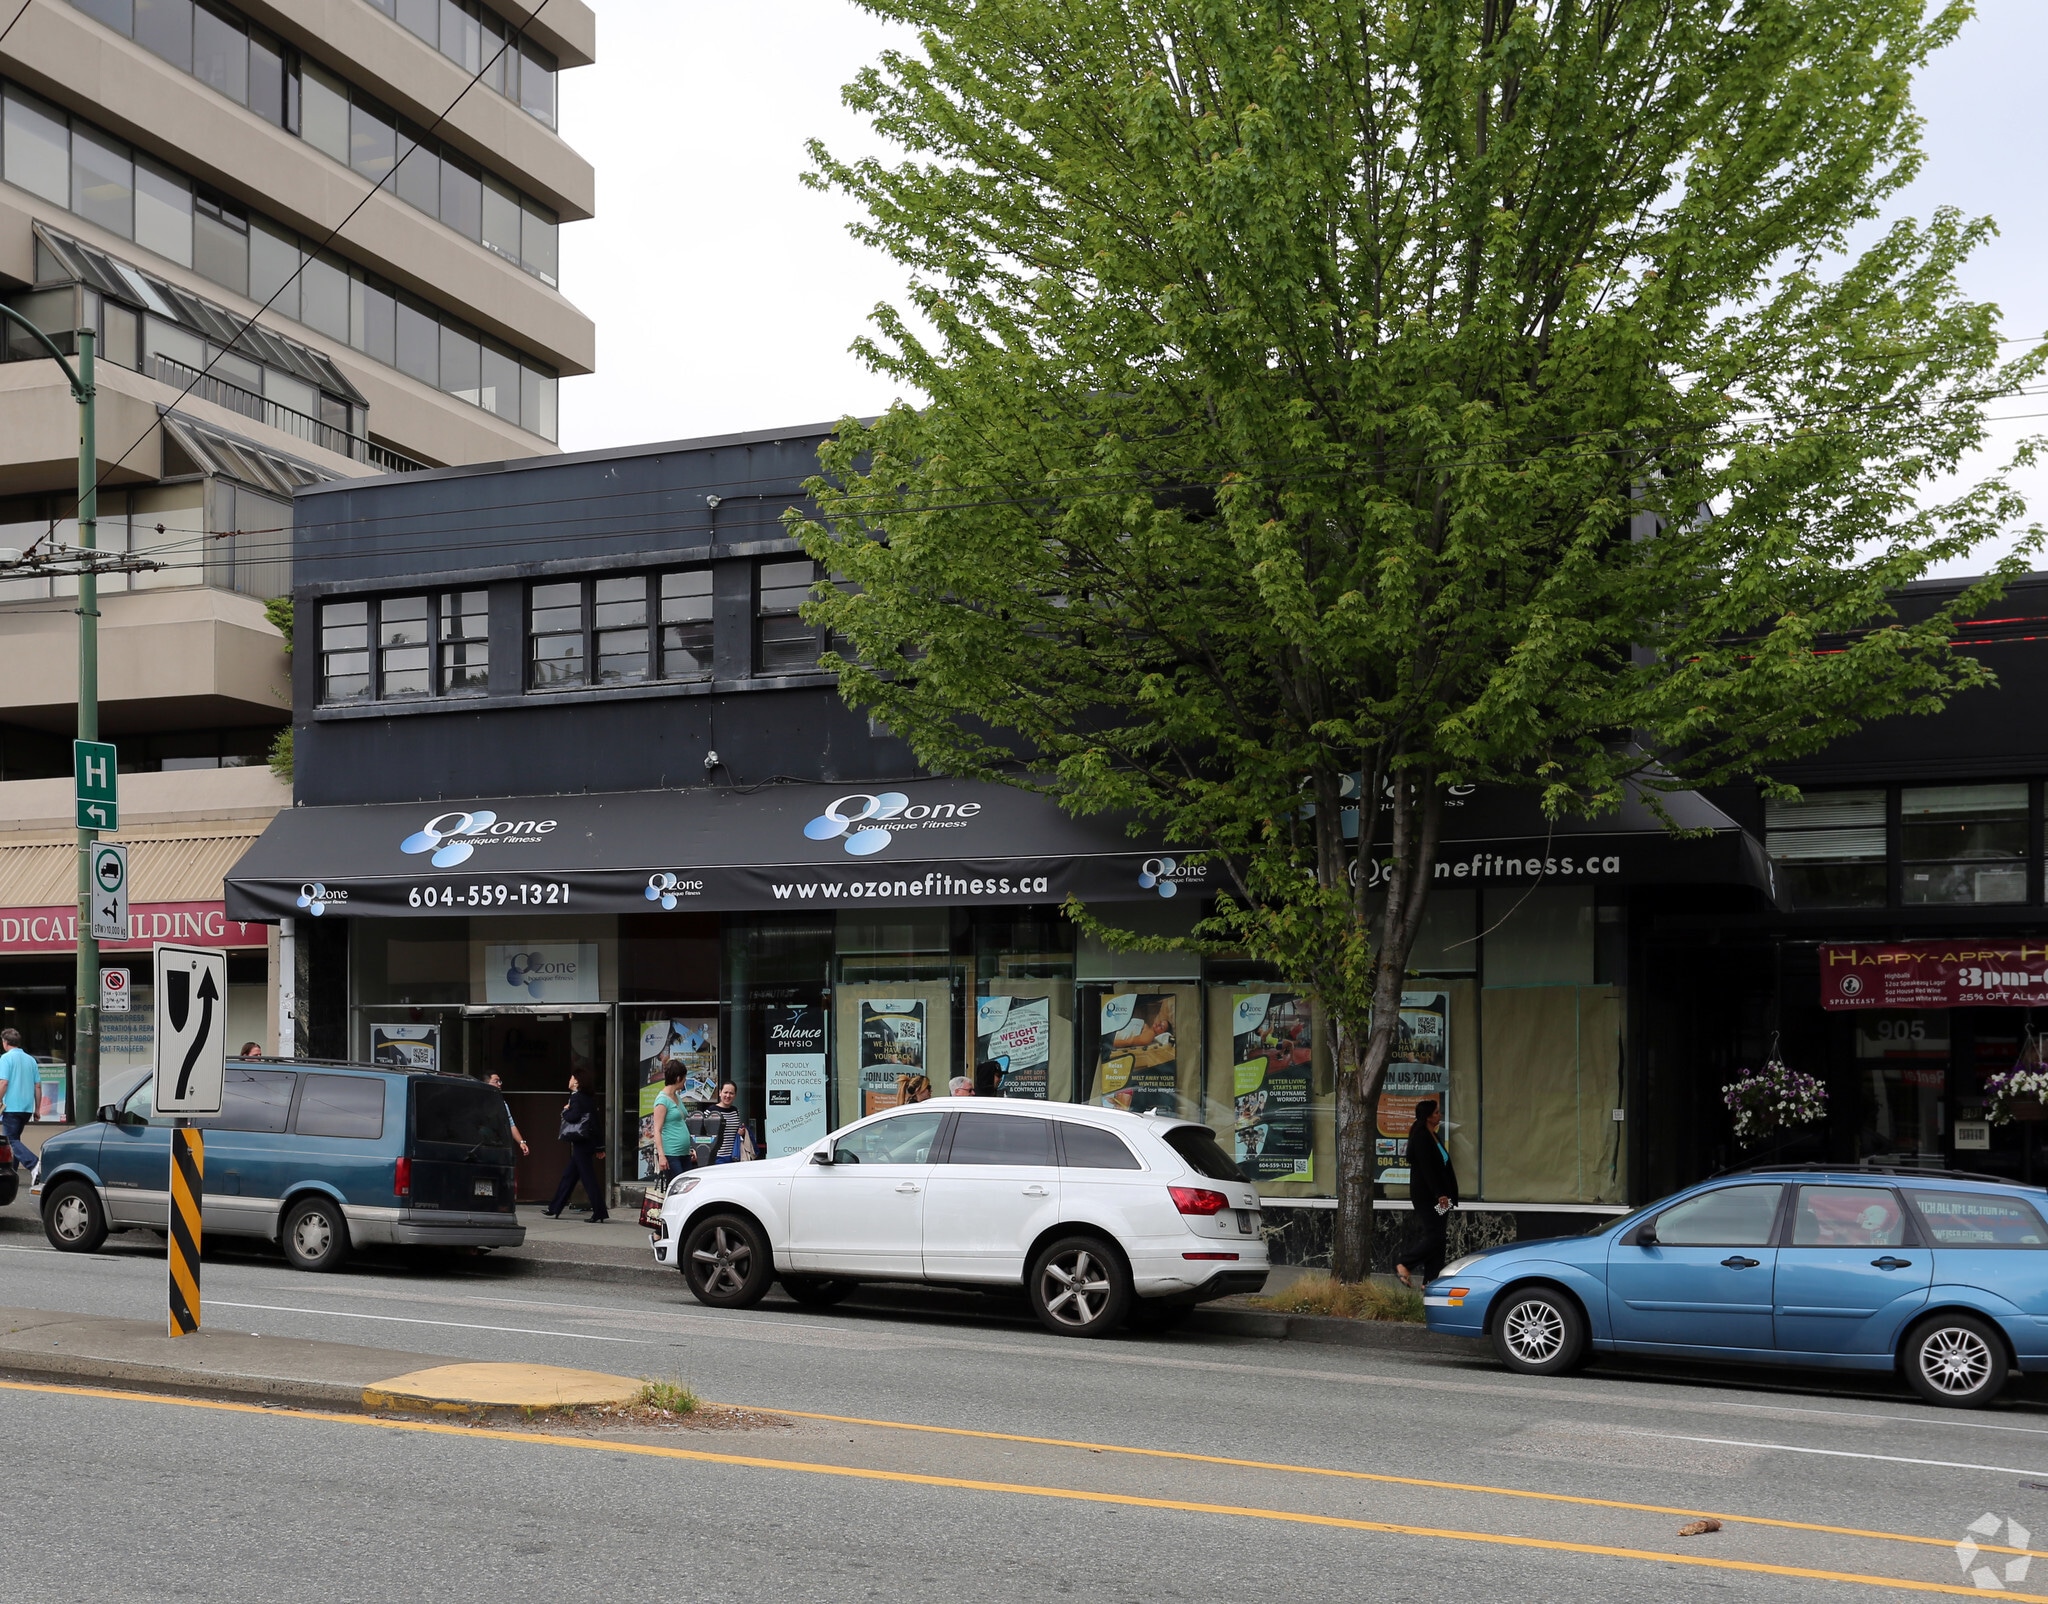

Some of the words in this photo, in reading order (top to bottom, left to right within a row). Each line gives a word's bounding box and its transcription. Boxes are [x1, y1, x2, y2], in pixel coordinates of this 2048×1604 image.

[86, 755, 107, 788] H
[857, 822, 918, 832] boutique
[922, 820, 968, 830] fitness
[447, 837, 500, 846] boutique
[502, 835, 542, 844] fitness
[771, 873, 1048, 899] www.ozonefitness.ca
[408, 883, 570, 908] 604-559-1321
[1959, 993, 1984, 1001] 25%
[1986, 992, 2010, 1001] OFF
[2012, 993, 2035, 1001] ALL
[100, 1024, 131, 1032] LTERATION
[770, 1024, 822, 1039] Balance
[1000, 1026, 1038, 1042] WEIGHT
[1877, 1019, 1926, 1041] 905
[778, 1040, 813, 1048] PHYSIO
[1009, 1035, 1036, 1048] LOSS
[863, 1071, 881, 1082] JOIN
[883, 1071, 895, 1082] US
[1398, 1071, 1411, 1082] US
[1412, 1071, 1442, 1083] TODAY
[874, 1082, 883, 1090] get
[771, 1122, 791, 1134] WATCH
[790, 1116, 804, 1125] THIS
[1377, 1156, 1393, 1167] 604
[1937, 1202, 1951, 1214] ALL
